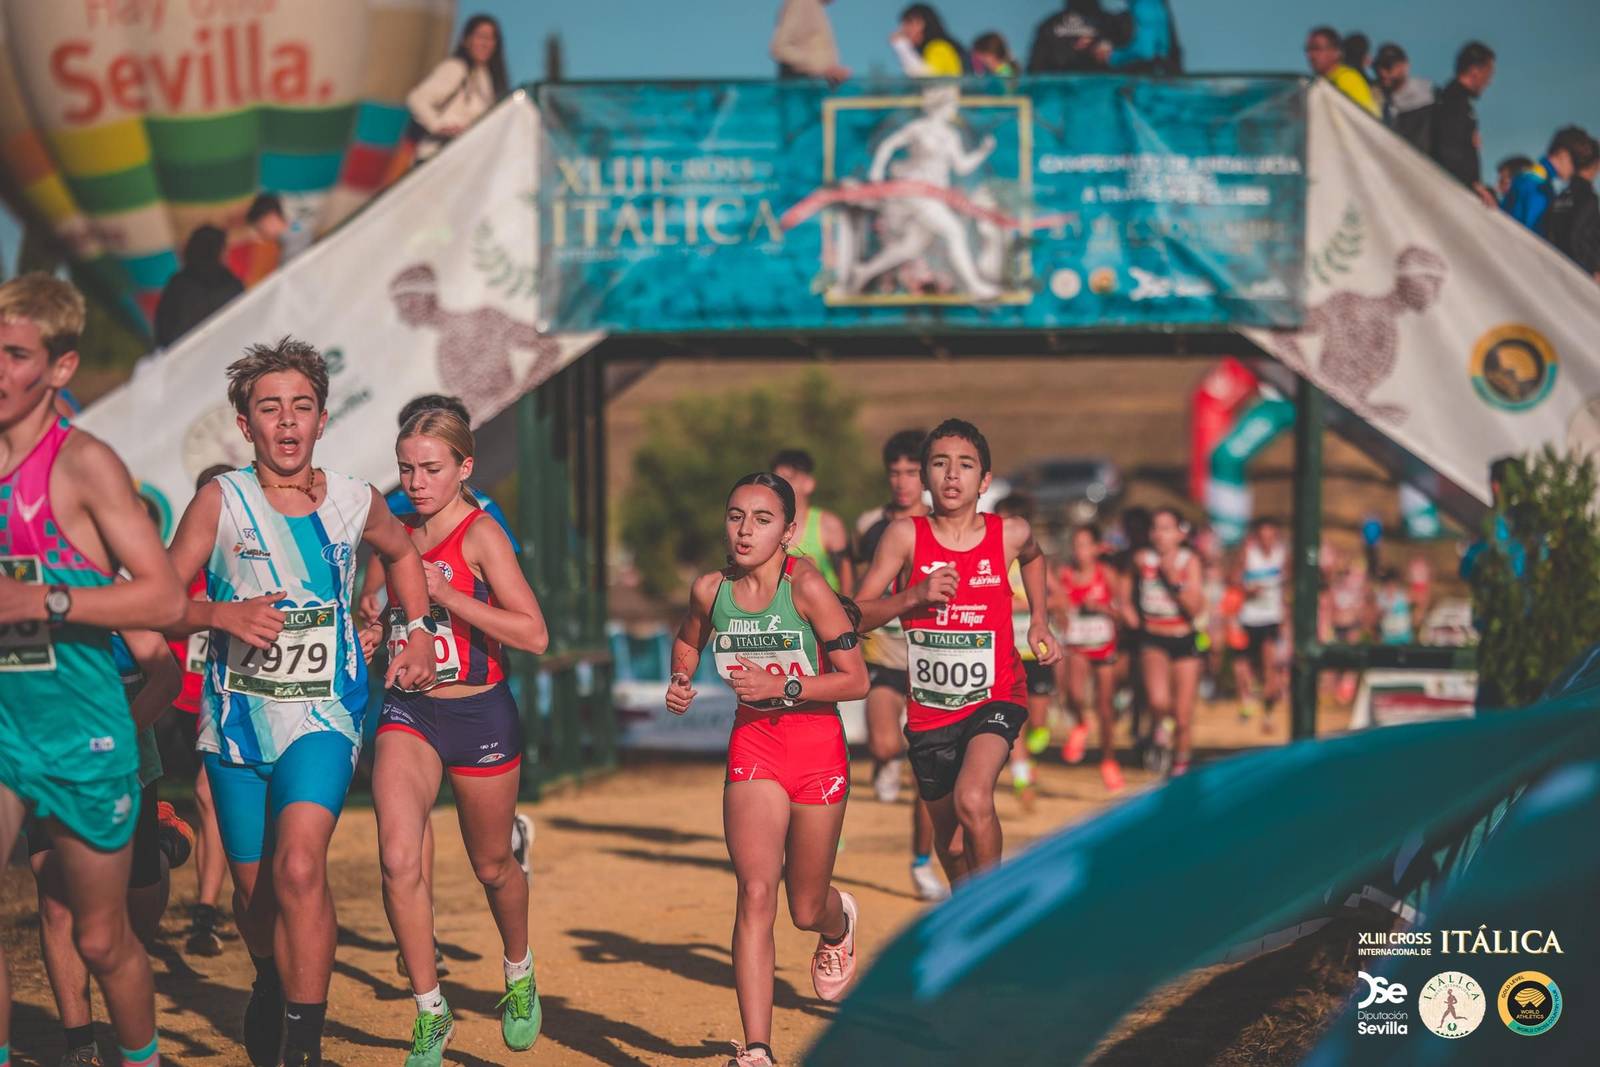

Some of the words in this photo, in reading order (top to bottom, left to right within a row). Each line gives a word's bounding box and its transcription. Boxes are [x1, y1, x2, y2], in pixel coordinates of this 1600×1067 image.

[50, 22, 334, 124] Sevilla.
[736, 634, 778, 647] ITÁLICA
[929, 632, 971, 645] ITÁLICA
[241, 643, 328, 674] 7979
[916, 658, 987, 688] 8009
